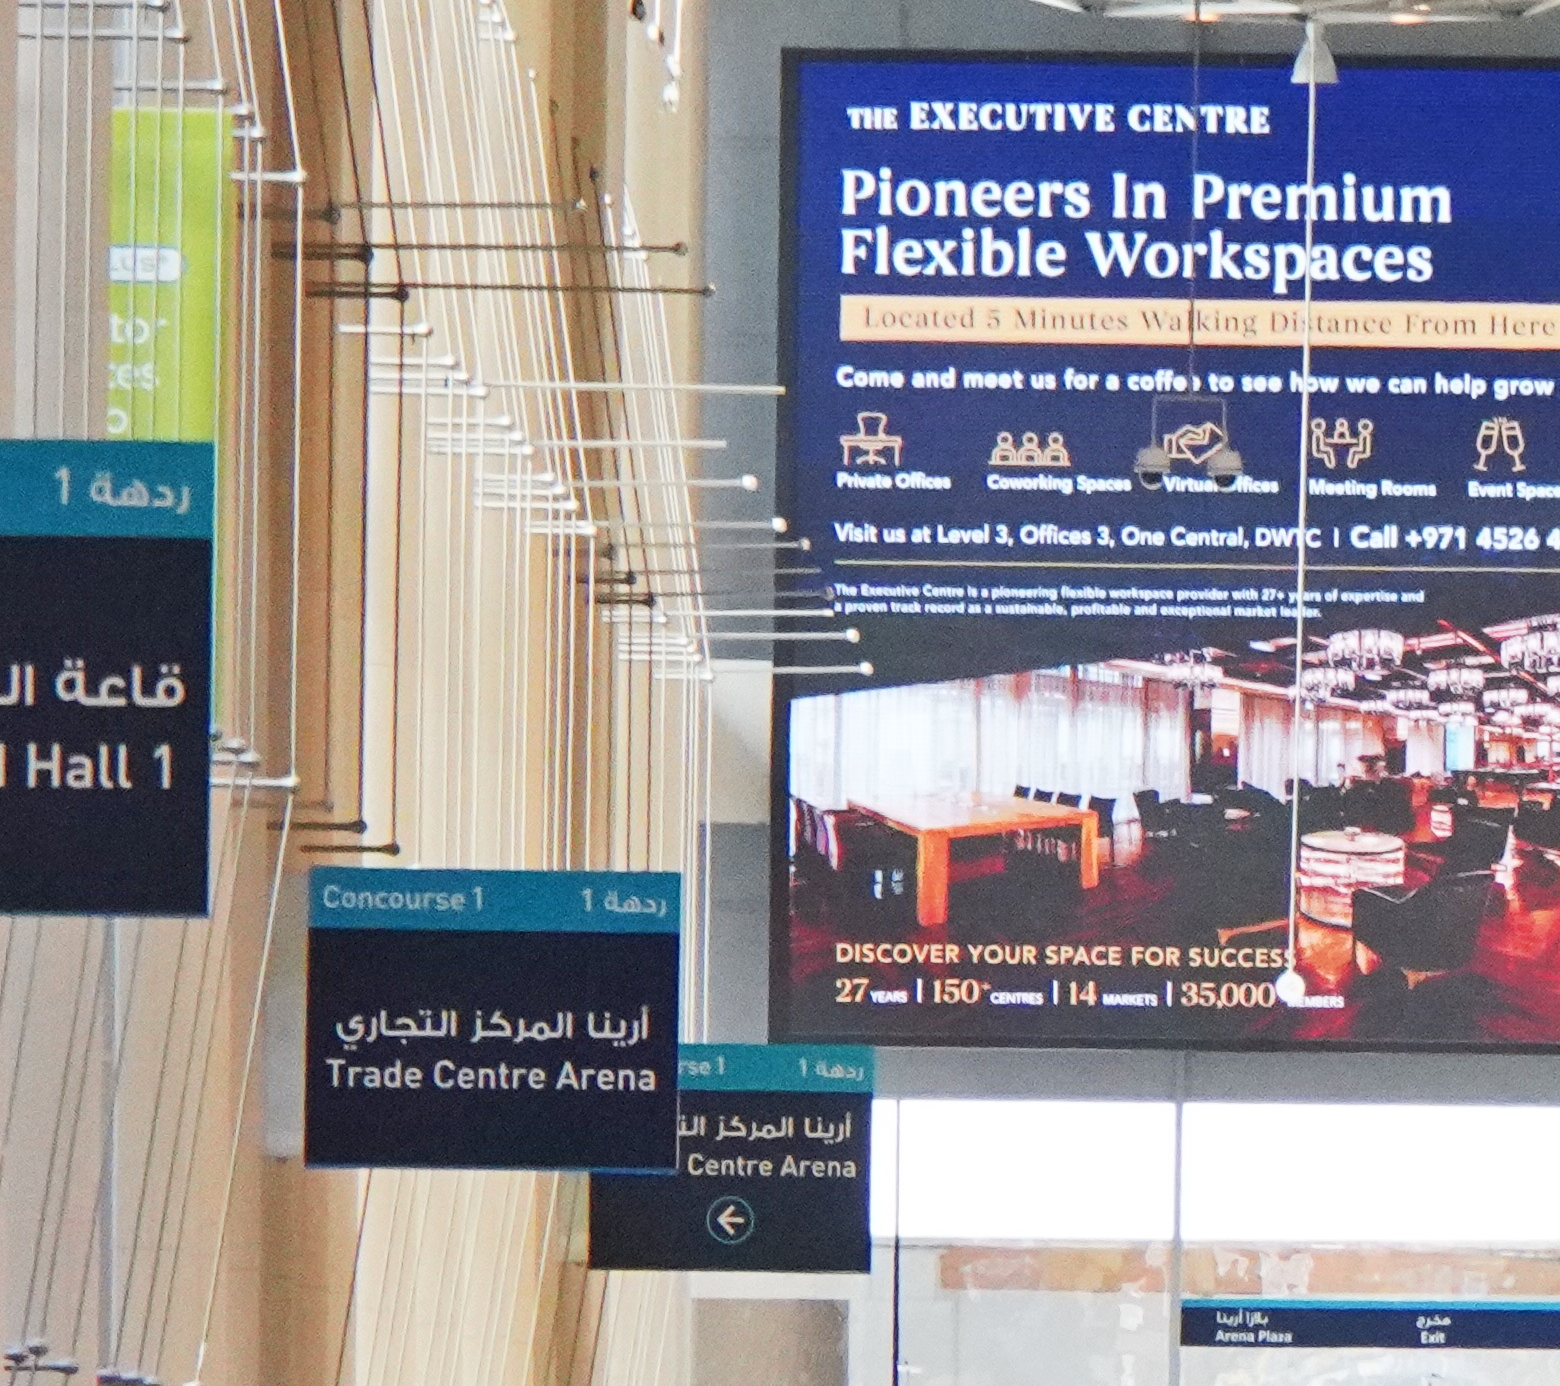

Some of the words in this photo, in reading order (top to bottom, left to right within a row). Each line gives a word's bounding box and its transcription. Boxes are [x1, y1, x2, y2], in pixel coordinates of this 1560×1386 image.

[847, 107, 898, 130] THE
[910, 101, 1115, 132] EXECUTIVE
[1127, 104, 1270, 134] CENTRE
[841, 167, 1091, 219] Pioneers
[1112, 172, 1167, 219] In
[1193, 171, 1452, 224] Premium
[841, 225, 1067, 277] Flexible
[1085, 227, 1434, 295] Workspaces
[864, 306, 975, 330] Located
[986, 307, 1002, 330] 5
[1014, 307, 1129, 332] Minutes
[1405, 313, 1476, 336] From
[1489, 314, 1556, 337] Here
[836, 366, 904, 389] Come
[911, 367, 956, 389] and
[963, 369, 1026, 390] meet
[1031, 373, 1057, 390] us
[1063, 368, 1099, 390] for
[1105, 374, 1121, 391] a
[1208, 372, 1235, 393] to
[1241, 376, 1283, 393] see
[1345, 376, 1381, 393] we
[1388, 377, 1427, 395] can
[1435, 373, 1487, 399] help
[1493, 380, 1555, 401] grow
[55, 466, 71, 506] 1
[89, 471, 192, 516] ردهة
[836, 472, 892, 490] Private
[895, 472, 952, 490] Offices
[986, 474, 1073, 494] Coworking
[1077, 475, 1132, 495] Spaces
[1308, 478, 1377, 499] Meeting
[1381, 480, 1437, 498] Rooms
[1468, 481, 1513, 499] Event
[834, 522, 877, 544] Visit
[883, 527, 907, 544] us
[911, 525, 932, 544] at
[938, 524, 990, 545] Level
[995, 525, 1015, 548] 3,
[1019, 524, 1092, 546] Offices
[1097, 525, 1116, 549] 3,
[1122, 526, 1165, 547] One
[1170, 526, 1250, 549] Central,
[1256, 527, 1322, 549] DWTC
[1350, 524, 1399, 550] Call
[1404, 527, 1467, 551] +971
[1476, 527, 1541, 552] 4526
[834, 583, 858, 597] The
[55, 657, 186, 710] قاعة
[27, 744, 132, 790] Hall
[153, 745, 173, 791] 1
[322, 884, 467, 912] Concourse
[472, 886, 483, 912] 1
[580, 887, 592, 913] 1
[603, 888, 667, 918] ردهة
[836, 943, 960, 964] DISCOVER
[968, 944, 1036, 965] YOUR
[1045, 946, 1124, 967] SPACE
[1131, 947, 1181, 967] FOR
[835, 978, 868, 1004] 27
[870, 990, 908, 1004] YEARS
[990, 991, 1044, 1006] CENTRES
[1069, 980, 1098, 1004] 14
[1102, 993, 1158, 1007] MARKETS
[335, 1006, 457, 1051] التجاري
[469, 1009, 574, 1044] المركز
[587, 1005, 651, 1048] أرينا
[326, 1059, 422, 1089] Trade
[432, 1059, 545, 1091] Centre
[554, 1062, 656, 1092] Arena
[717, 1055, 726, 1075] 1
[800, 1056, 808, 1076] 1
[715, 1114, 795, 1141] المركز
[803, 1111, 853, 1146] أرينا
[688, 1153, 774, 1176] Centre
[780, 1154, 857, 1178] Arena
[1215, 1329, 1255, 1344] Arena
[1258, 1329, 1293, 1344] Plaza
[1420, 1330, 1446, 1344] Exit
